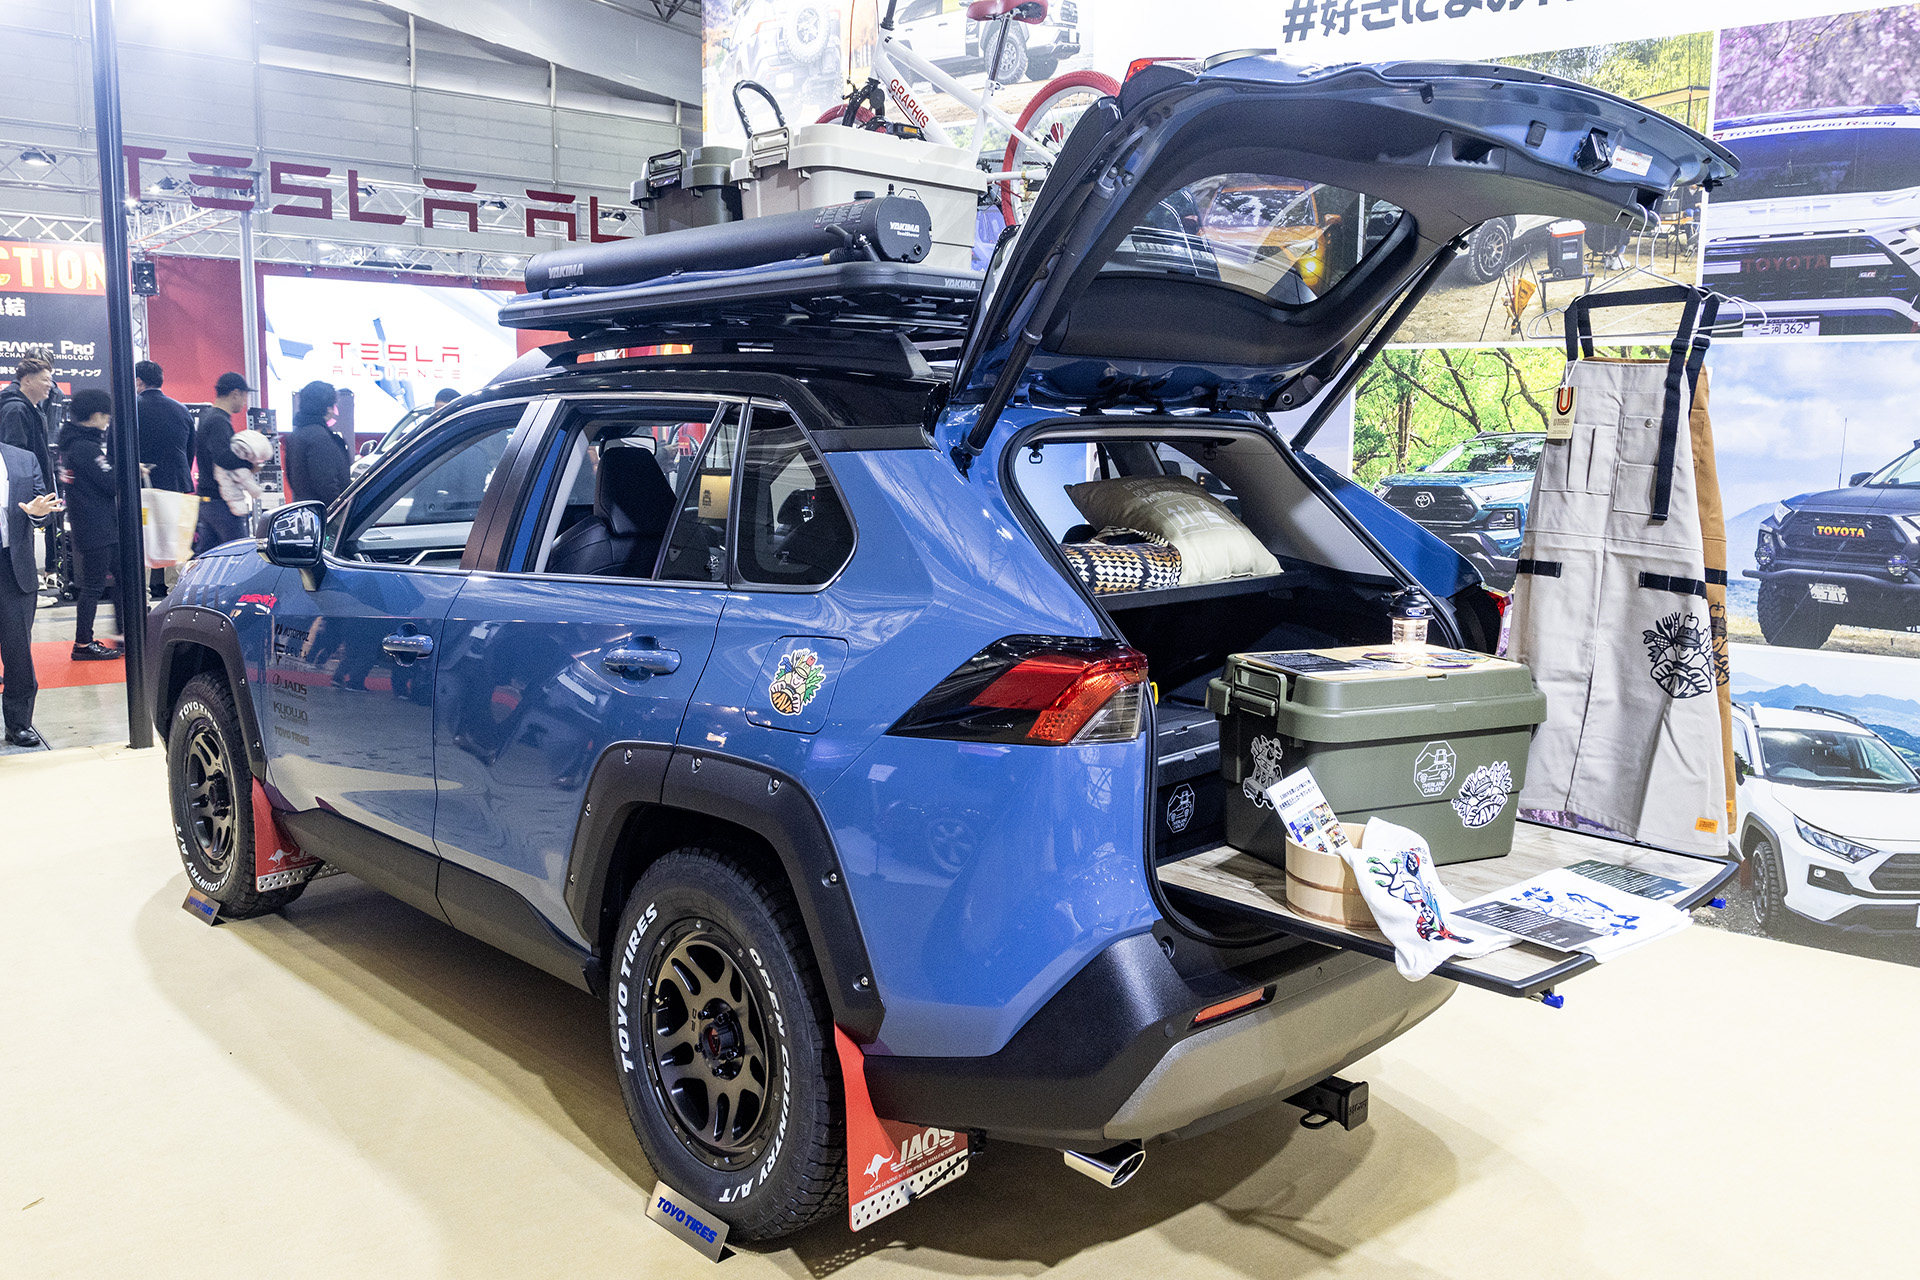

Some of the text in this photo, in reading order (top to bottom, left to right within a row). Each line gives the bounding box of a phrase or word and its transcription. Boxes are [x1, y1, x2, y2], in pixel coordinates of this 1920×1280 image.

[890, 79, 929, 128] GRAPHIS
[1727, 127, 1784, 137] TOYOTA
[123, 145, 478, 233] TESLA
[889, 221, 920, 233] YAKIMA
[548, 263, 584, 279] YAKIMA
[1742, 255, 1828, 273] TOYOTA
[944, 278, 977, 289] YAKIMA
[332, 341, 460, 363] TESLA
[332, 365, 460, 380] ALLIANCE
[1816, 525, 1865, 538] TOYOTA
[282, 679, 307, 695] JAOS
[178, 701, 199, 720] TOYO
[274, 725, 291, 739] TOYO
[1422, 780, 1446, 789] OVERLAND
[174, 823, 220, 892] COUNTRY A/T
[200, 900, 214, 916] TIRES
[617, 902, 658, 1073] TOYO TIRES
[718, 947, 791, 1203] OPEN COUNTRY A/T
[890, 1127, 955, 1173] JAOS
[881, 1175, 898, 1187] LEADING
[906, 1160, 928, 1175] EQUIPMENT
[928, 1146, 957, 1163] MANUFACTURER
[657, 1196, 718, 1244] TOYO TIRES
